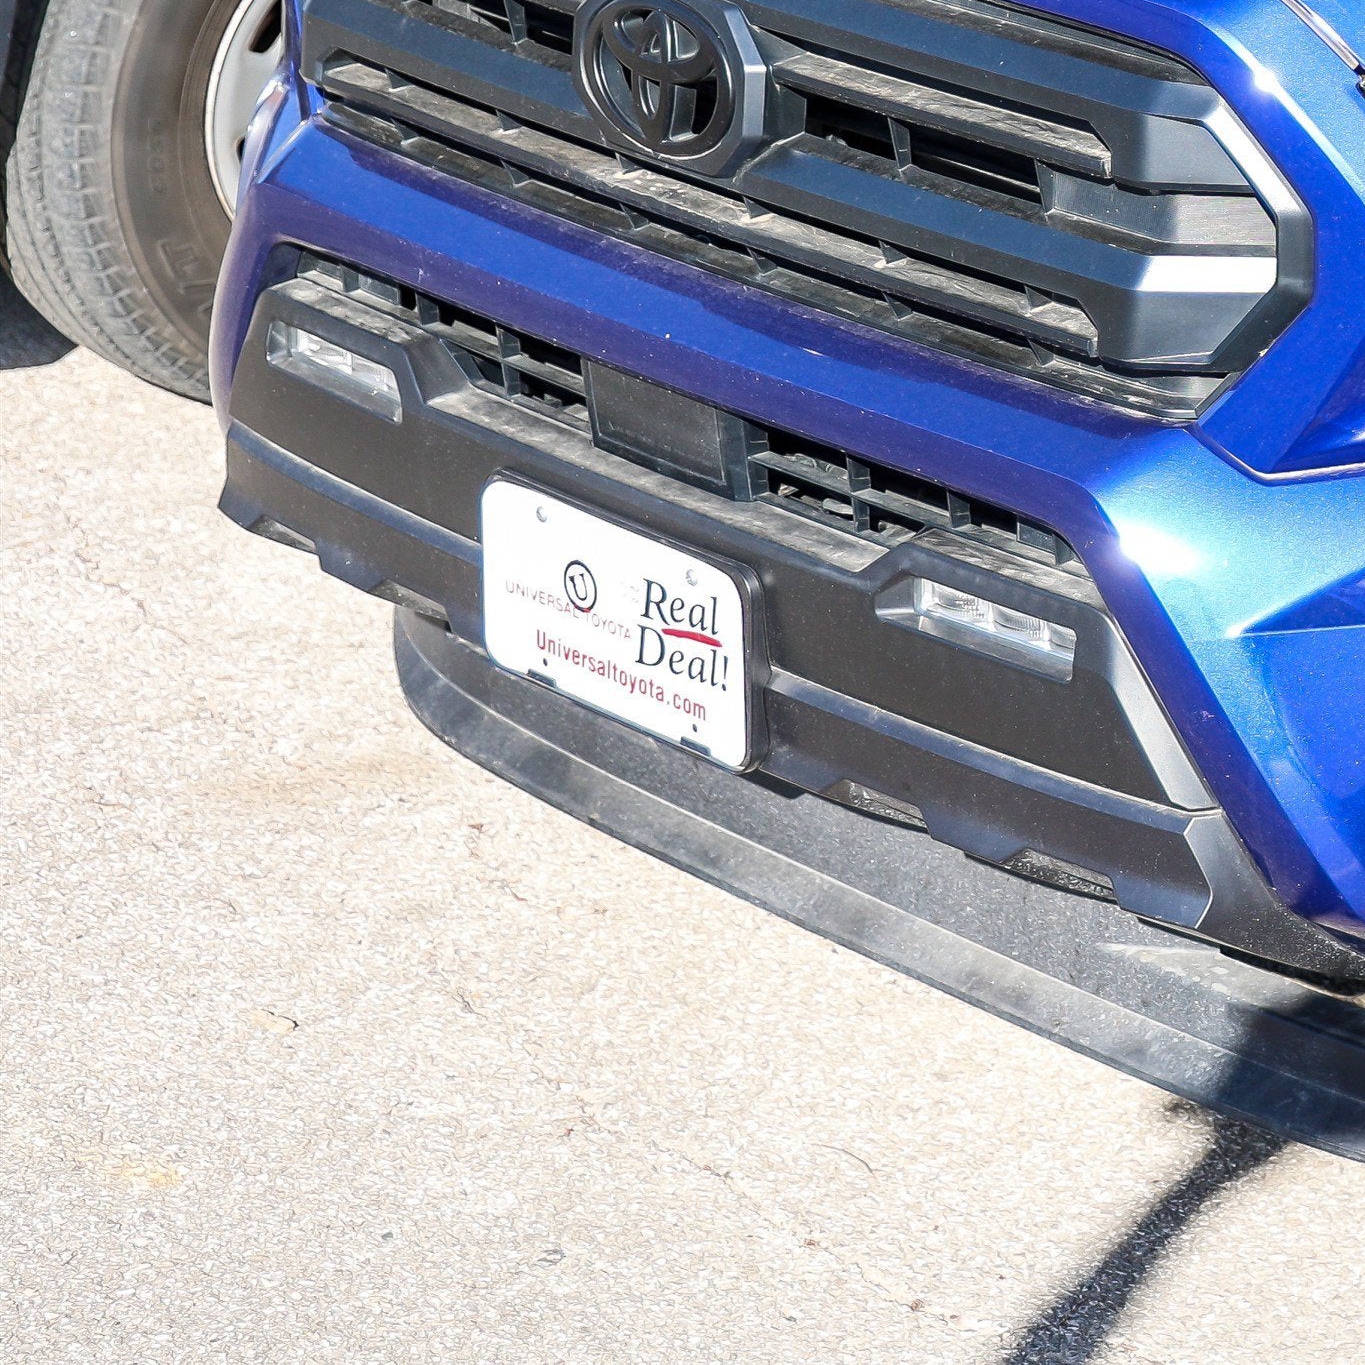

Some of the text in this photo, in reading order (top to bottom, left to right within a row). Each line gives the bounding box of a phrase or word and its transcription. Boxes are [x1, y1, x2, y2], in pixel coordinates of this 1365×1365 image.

[505, 579, 580, 619] UNIVERSAL
[568, 572, 588, 602] U
[640, 577, 719, 636] Real
[536, 629, 707, 722] Universaltoyota.com
[635, 623, 730, 692] Deal!
